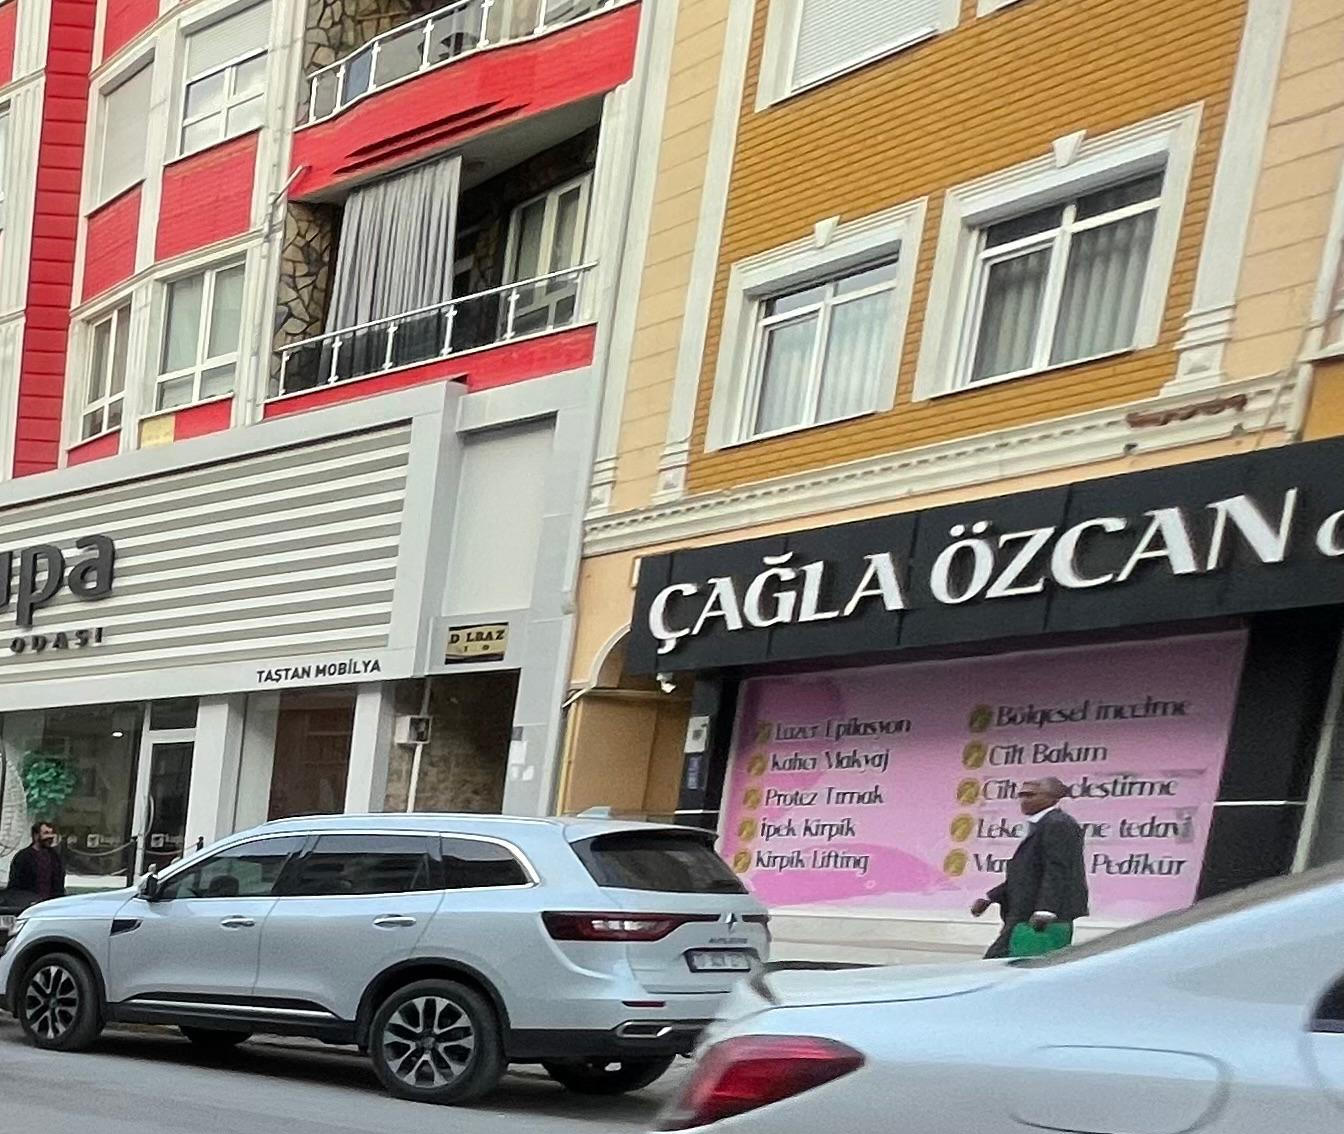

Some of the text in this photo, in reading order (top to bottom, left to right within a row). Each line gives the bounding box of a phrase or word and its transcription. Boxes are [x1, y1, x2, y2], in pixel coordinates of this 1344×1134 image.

[649, 551, 906, 654] ÇAĞLA
[929, 488, 1298, 605] ÖZCAN
[257, 659, 382, 684] TAŞTAN MOBİLYA
[989, 742, 1108, 766] Cilt Bakım
[765, 788, 819, 807] Protez
[803, 817, 856, 841] Kirpik
[977, 817, 1023, 839] Leke
[1119, 815, 1193, 839] tedavi
[755, 850, 870, 874] Kirpik Lifting
[1092, 853, 1189, 875] Pedikür
